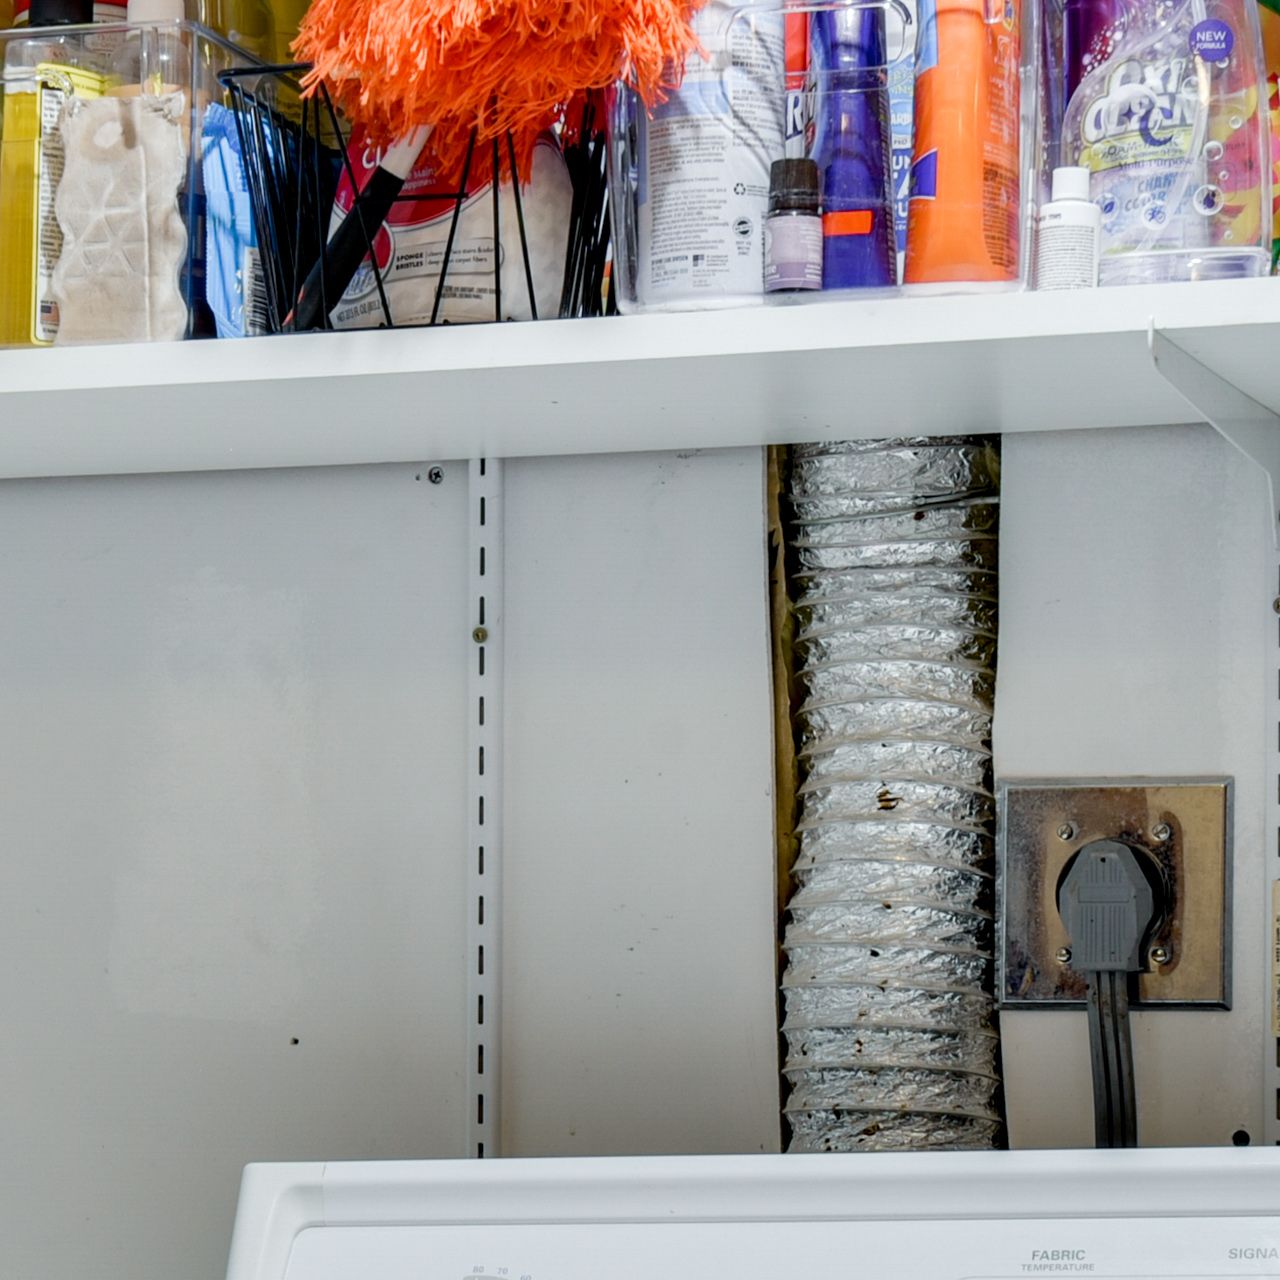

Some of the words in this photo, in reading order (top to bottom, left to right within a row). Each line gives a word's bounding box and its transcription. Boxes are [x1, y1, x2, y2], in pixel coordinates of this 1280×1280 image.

[1196, 30, 1227, 42] NEW
[396, 252, 423, 262] SPONGE
[396, 261, 423, 271] BRISTLES
[1031, 1250, 1086, 1261] FABRIC
[472, 1265, 485, 1274] 80
[497, 1267, 508, 1275] 70
[1021, 1263, 1095, 1272] TEMPERATURE
